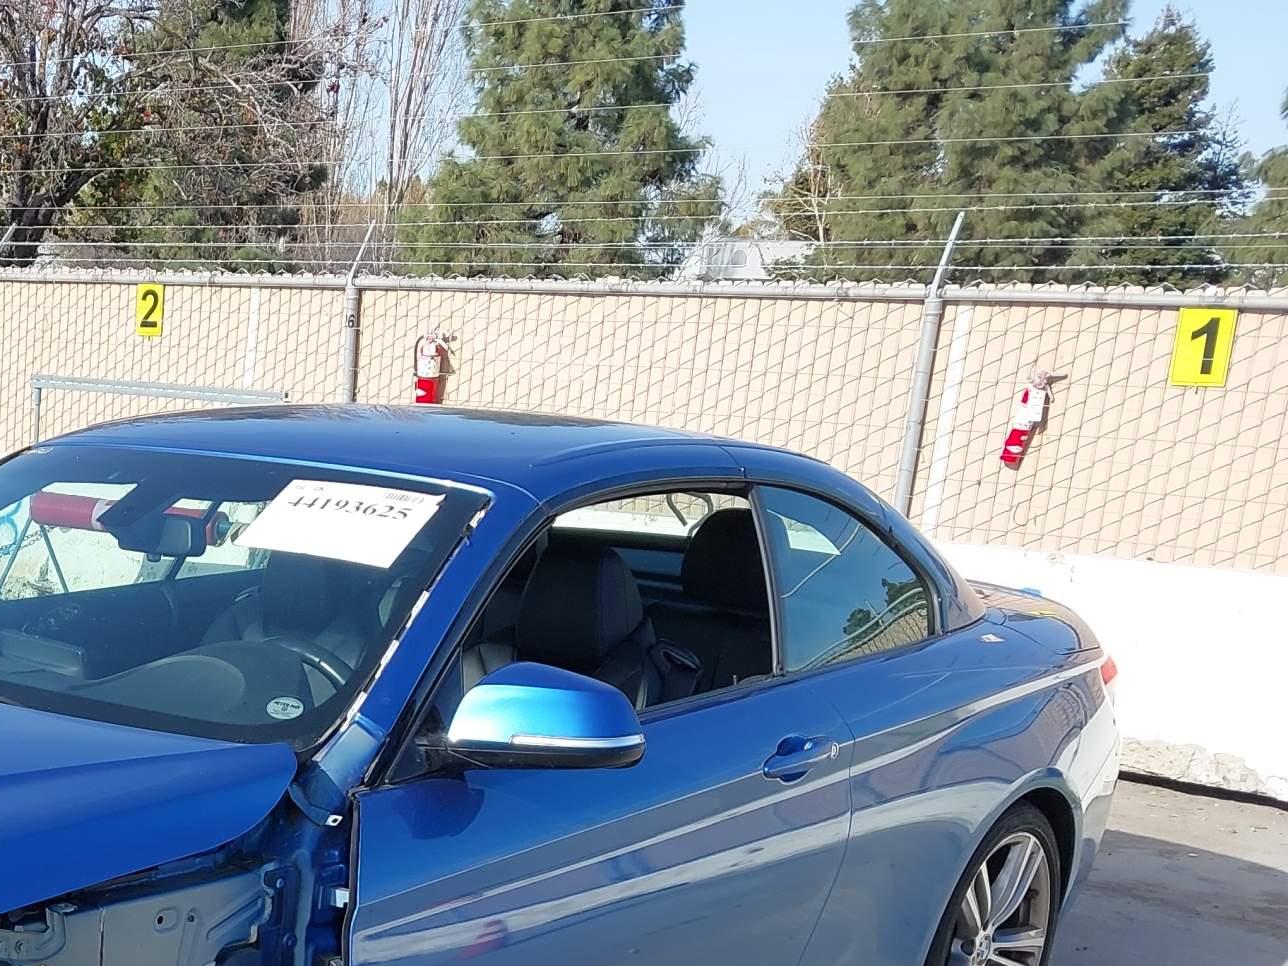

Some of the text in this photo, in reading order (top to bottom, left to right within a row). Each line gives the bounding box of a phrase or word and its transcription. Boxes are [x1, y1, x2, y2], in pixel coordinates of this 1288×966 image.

[140, 289, 159, 328] 2
[1190, 316, 1222, 375] 1
[287, 495, 413, 520] 44193625
